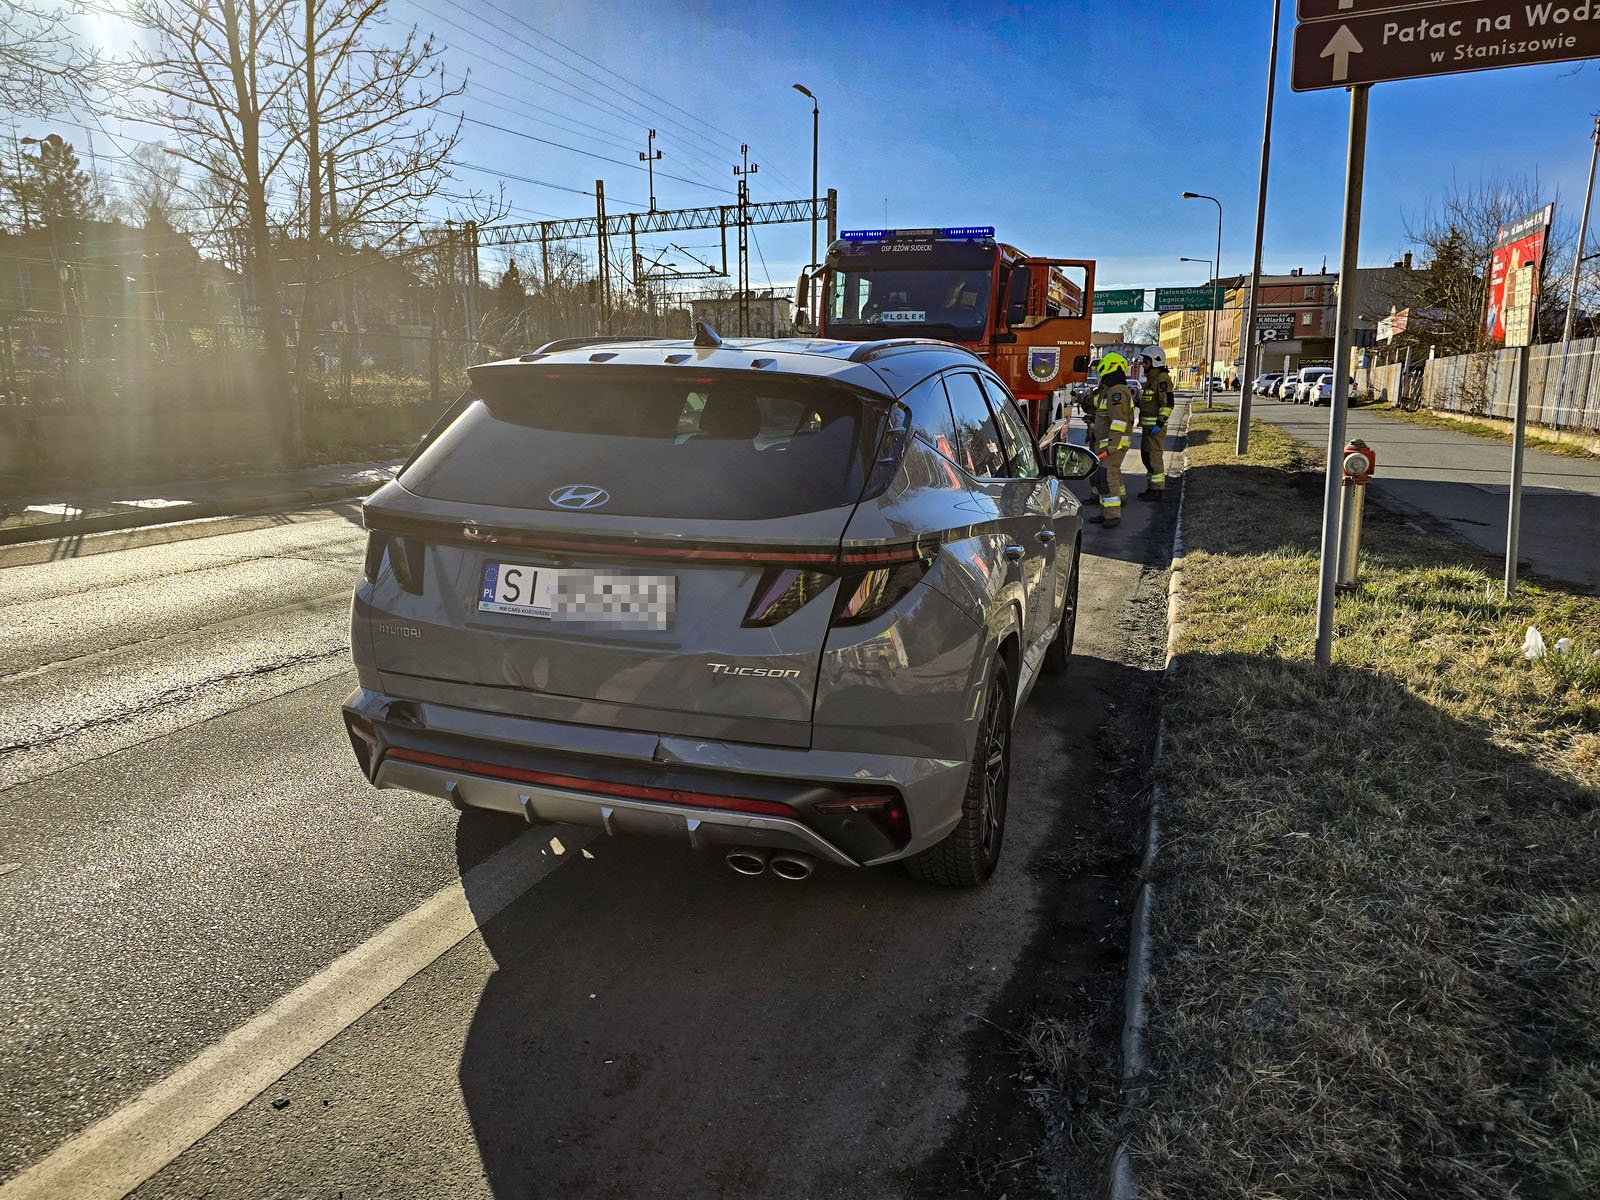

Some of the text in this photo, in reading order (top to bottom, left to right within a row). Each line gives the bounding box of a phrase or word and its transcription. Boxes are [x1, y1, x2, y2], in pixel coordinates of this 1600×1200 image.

[1383, 19, 1462, 45] Pałac
[1476, 14, 1511, 33] na
[1430, 32, 1577, 62] w Staniszowie
[910, 244, 932, 252] SUDECKI
[483, 588, 494, 598] PL
[502, 569, 538, 605] SI
[521, 607, 551, 616] KOŚCIUSZKI
[379, 624, 422, 638] HYUNDAI
